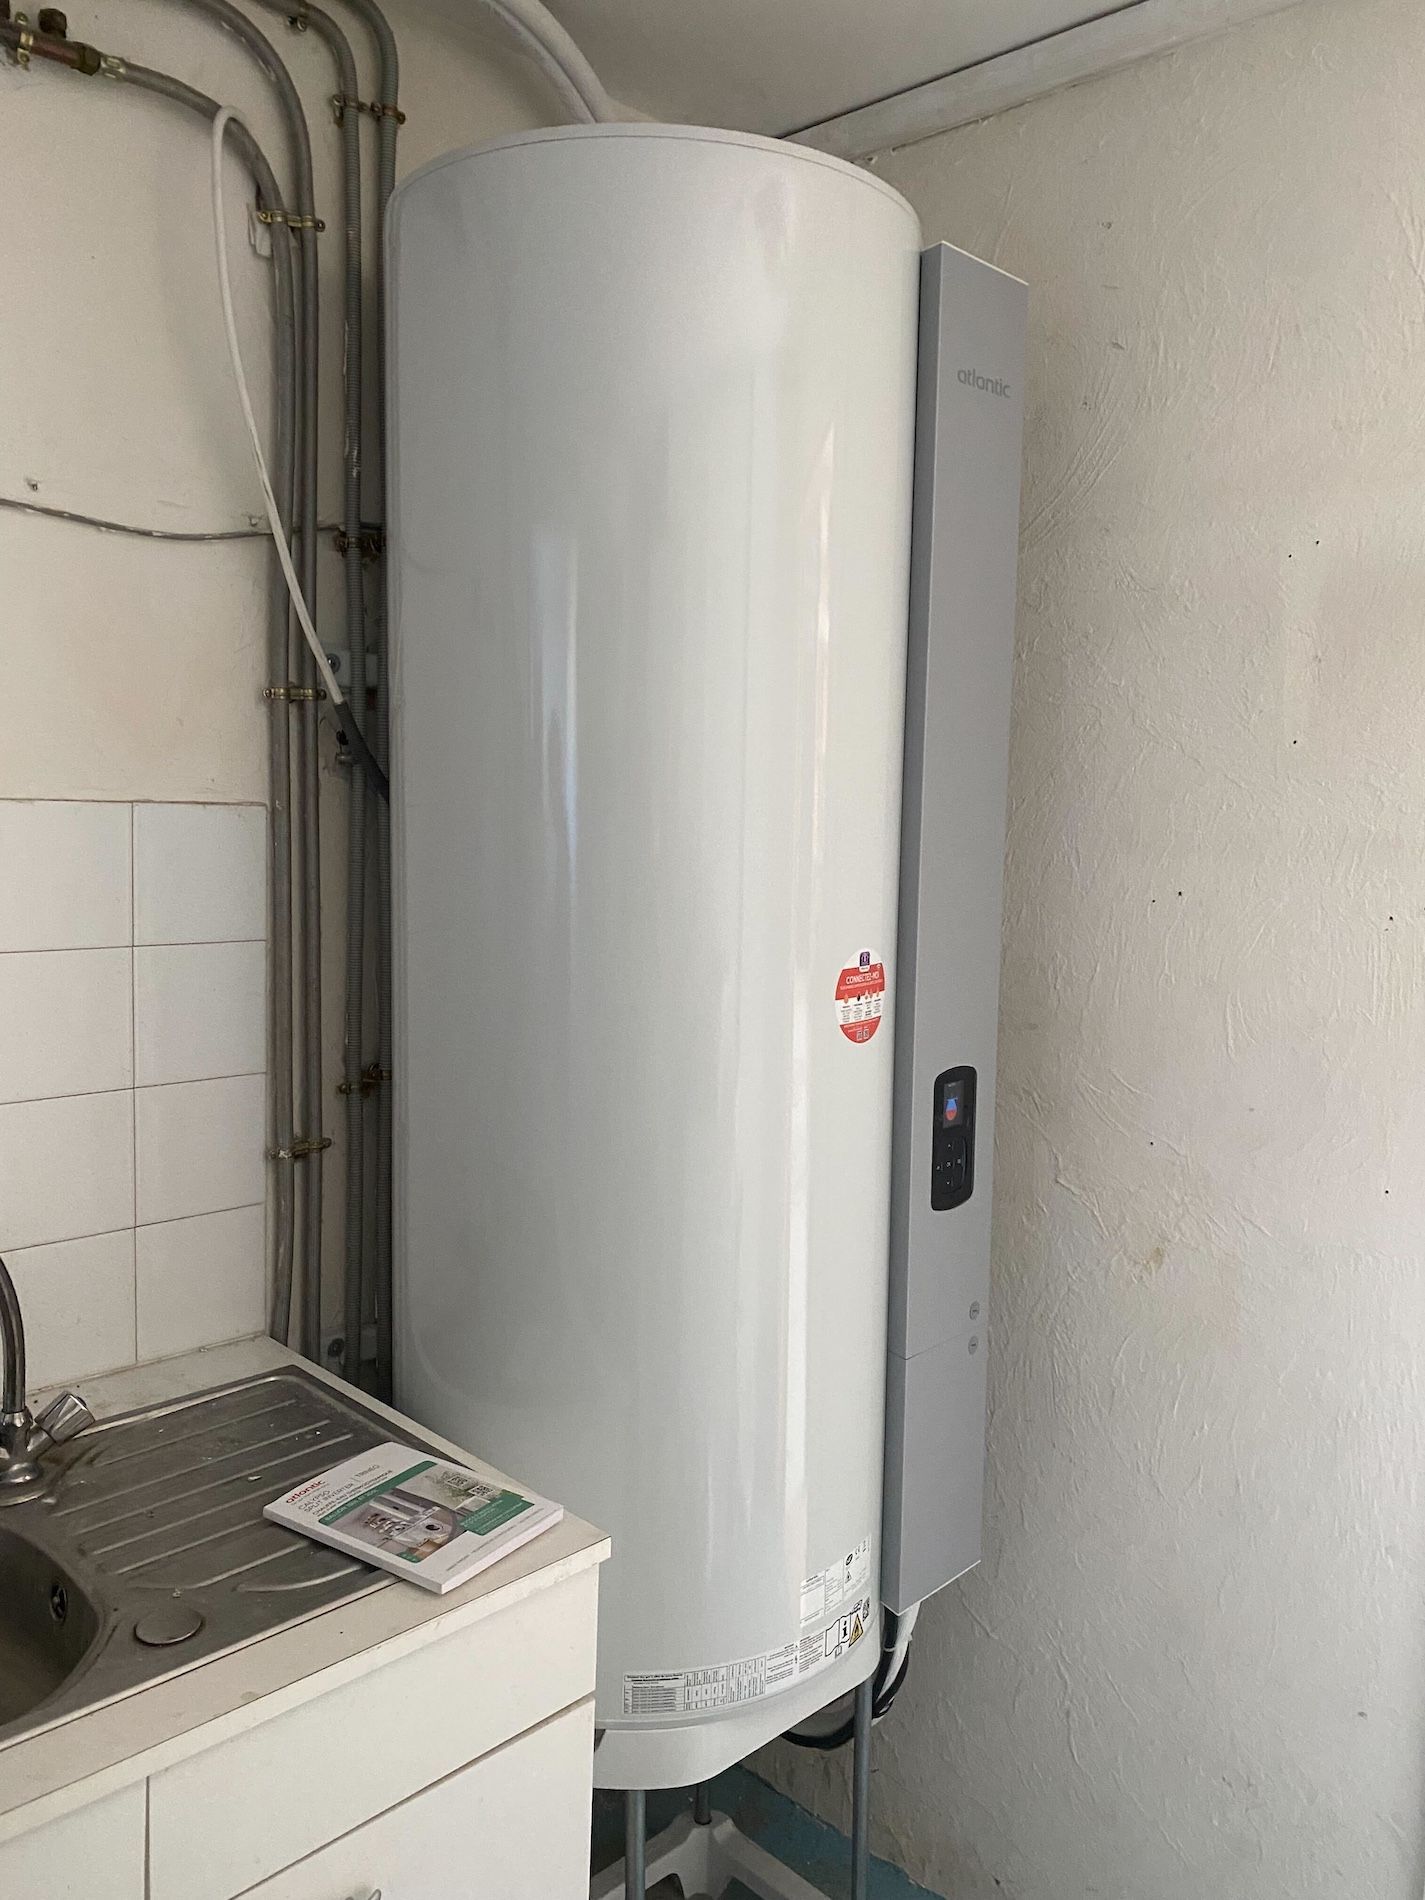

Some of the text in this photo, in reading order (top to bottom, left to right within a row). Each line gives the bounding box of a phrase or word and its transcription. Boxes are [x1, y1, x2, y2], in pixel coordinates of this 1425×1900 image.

[957, 368, 1011, 399] atlantic
[286, 1480, 326, 1504] atlantic
[298, 1490, 331, 1510] CALYPSO
[303, 1500, 322, 1513] SPLIT
[322, 1483, 354, 1501] INVERTER
